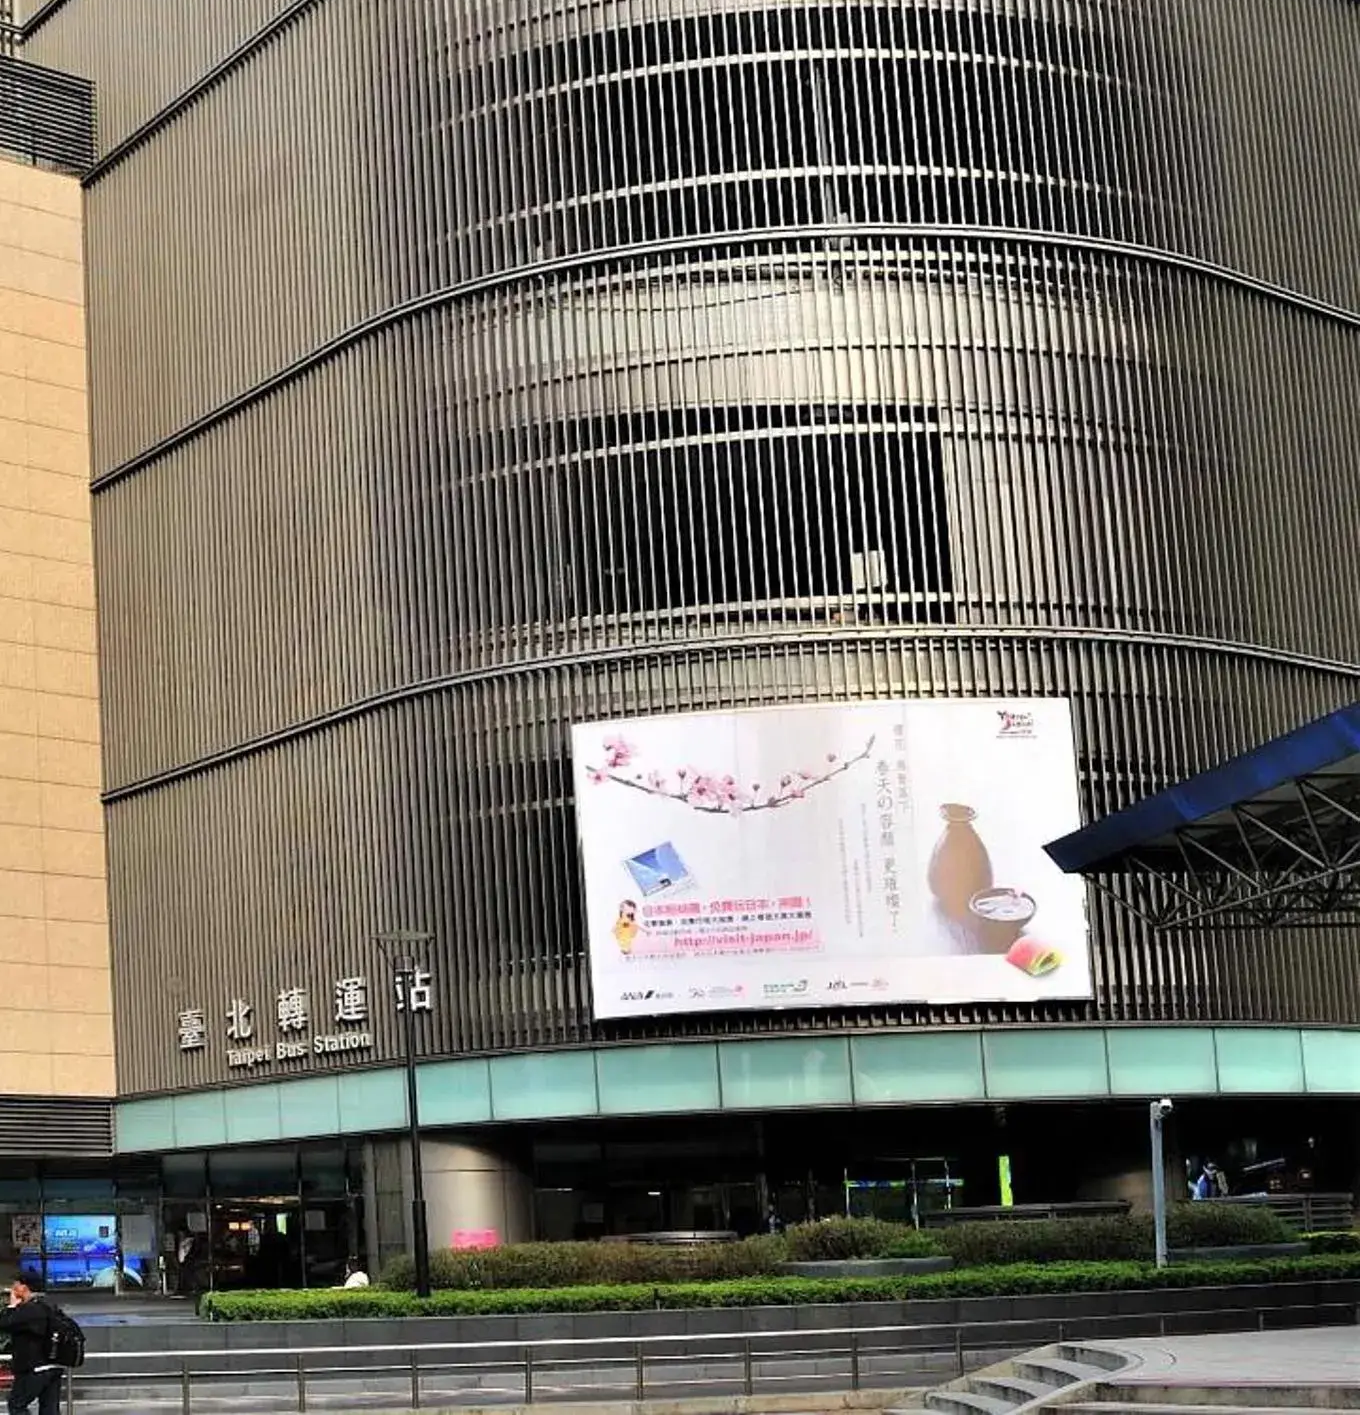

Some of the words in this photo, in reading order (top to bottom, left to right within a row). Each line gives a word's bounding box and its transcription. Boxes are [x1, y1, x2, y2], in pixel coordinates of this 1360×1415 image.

[674, 929, 813, 948] http://visit-japan.jp/
[178, 966, 433, 1049] 臺北轉運站
[226, 1045, 269, 1067] Taipei
[276, 1042, 307, 1059] Bus
[313, 1032, 371, 1054] Station
